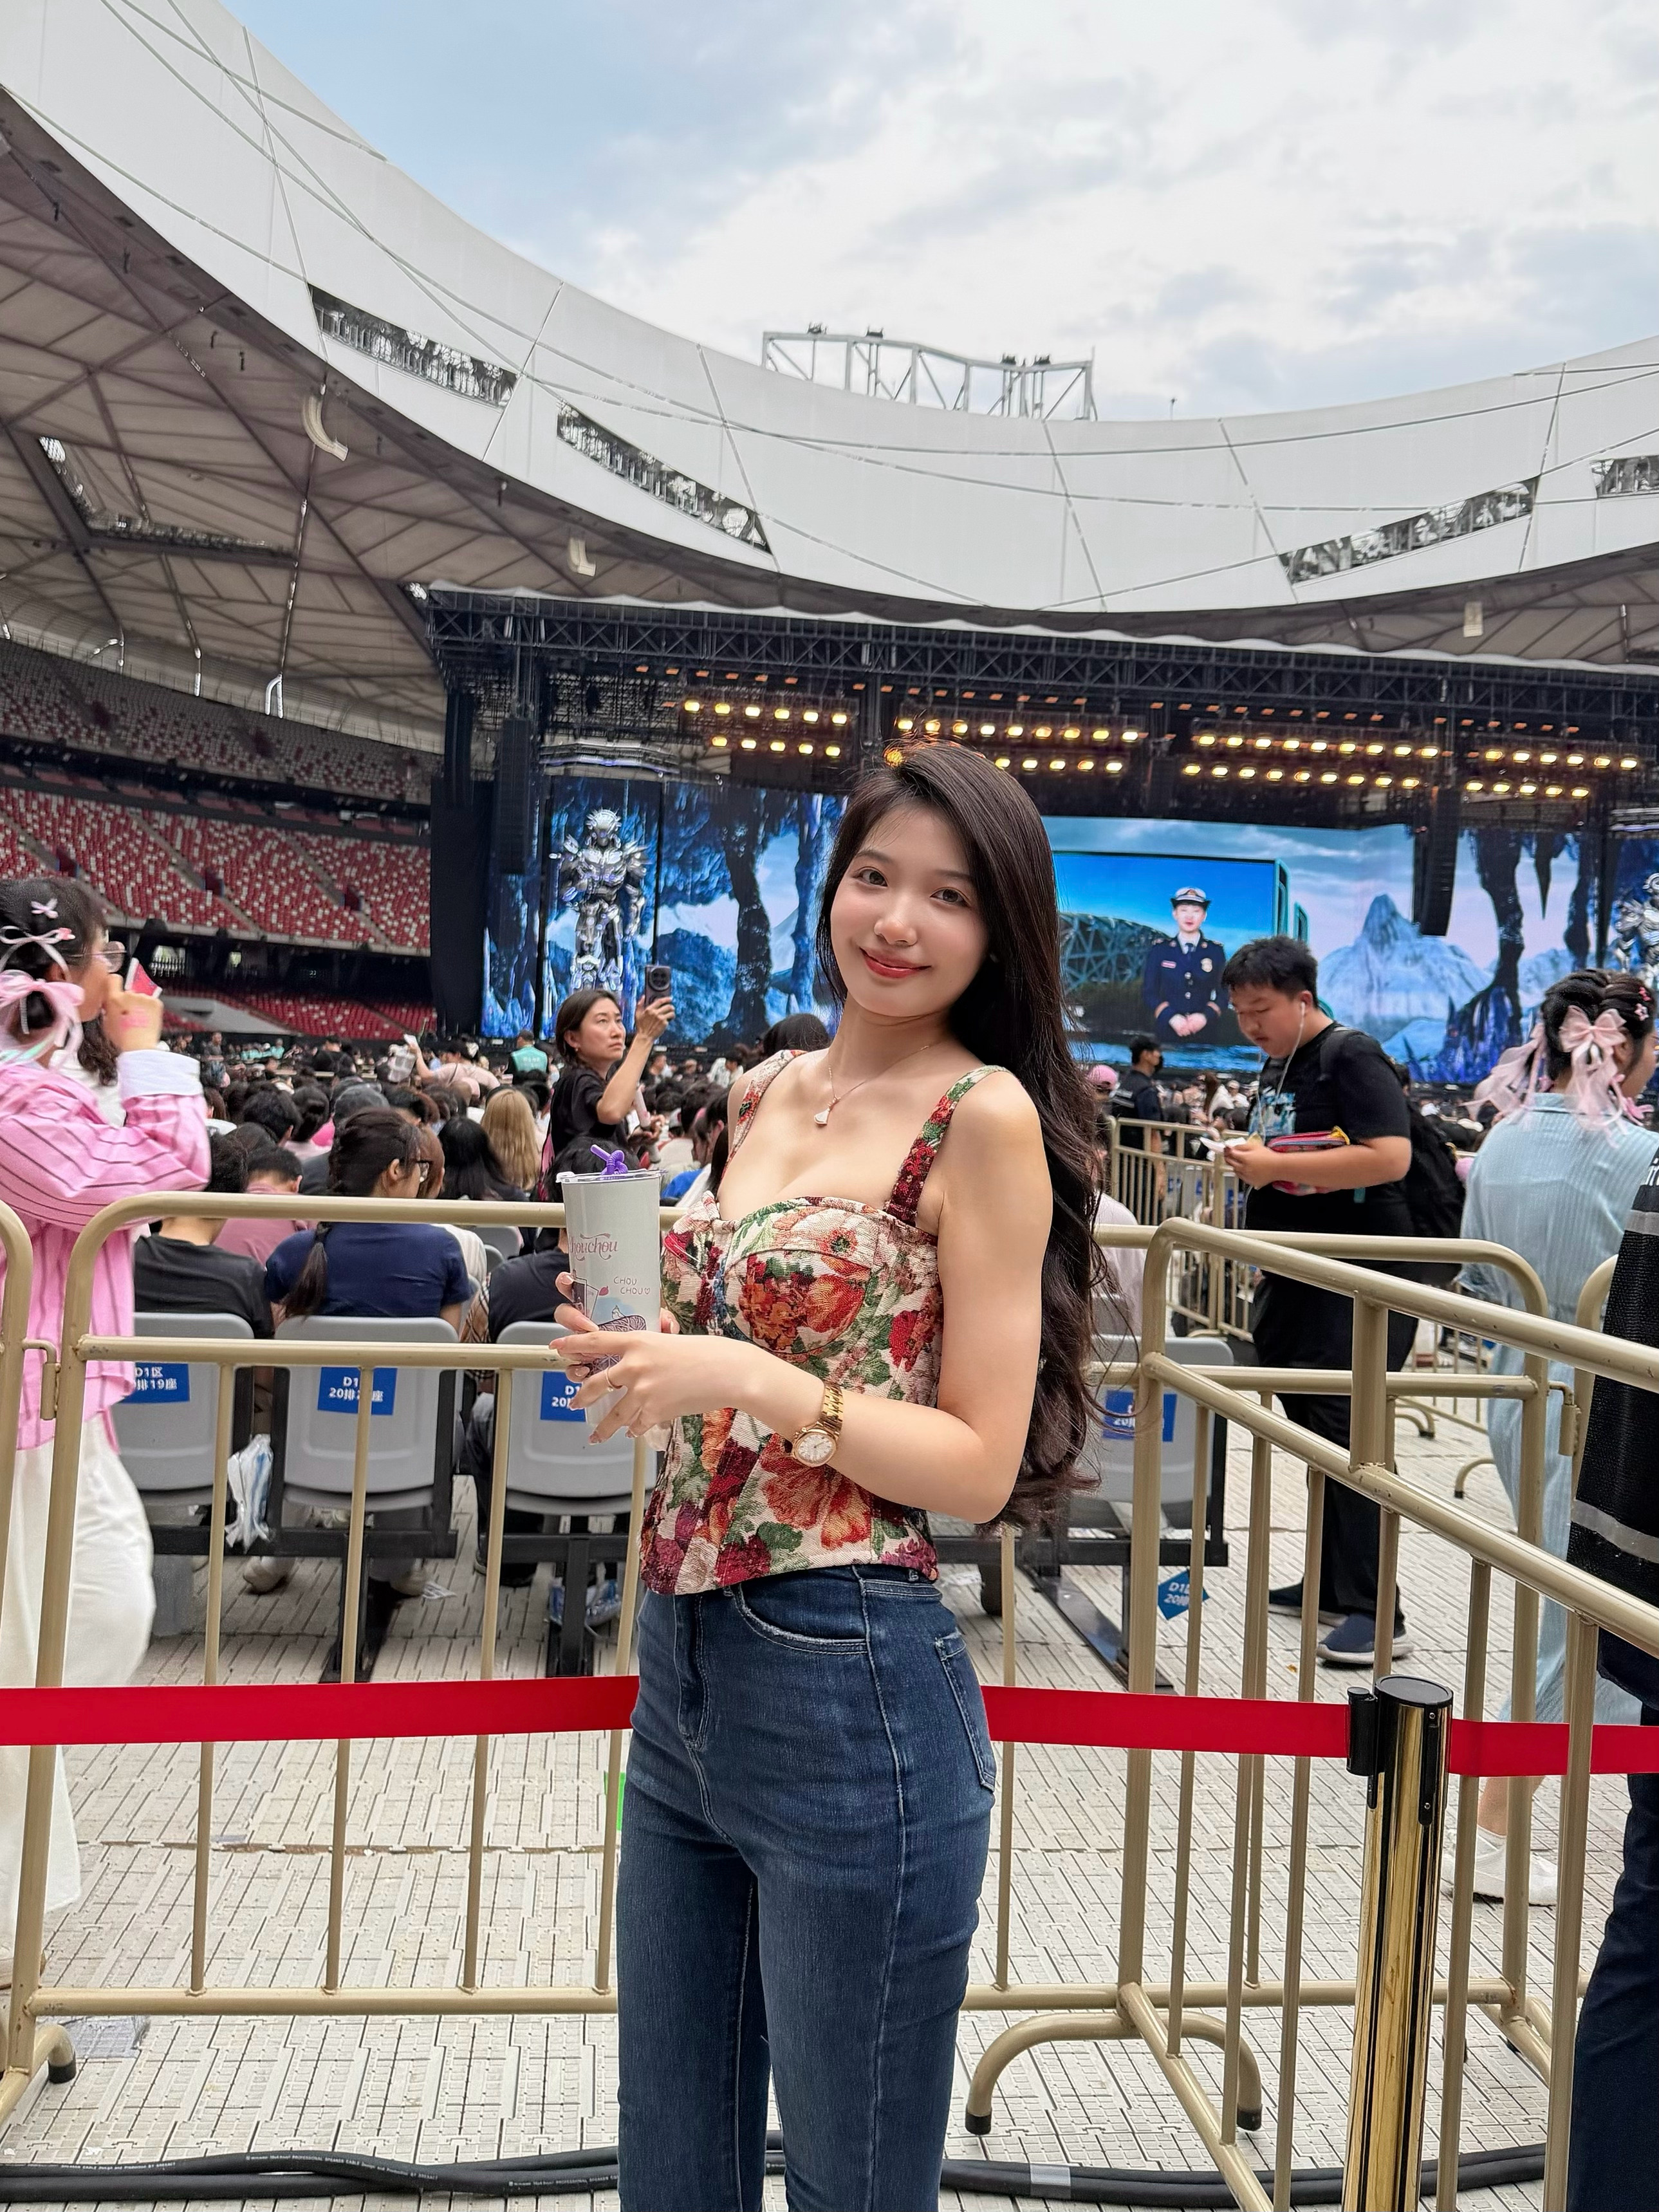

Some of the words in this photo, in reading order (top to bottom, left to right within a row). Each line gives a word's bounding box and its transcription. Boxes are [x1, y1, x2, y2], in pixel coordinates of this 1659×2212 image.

[570, 1234, 618, 1261] houchou
[613, 1276, 637, 1285] CHOU
[620, 1287, 643, 1295] CHOU
[135, 1366, 163, 1377] D1区
[134, 1378, 178, 1391] 排19座
[343, 1376, 358, 1387] D1
[329, 1387, 384, 1402] 20排座
[564, 1385, 580, 1395] D1
